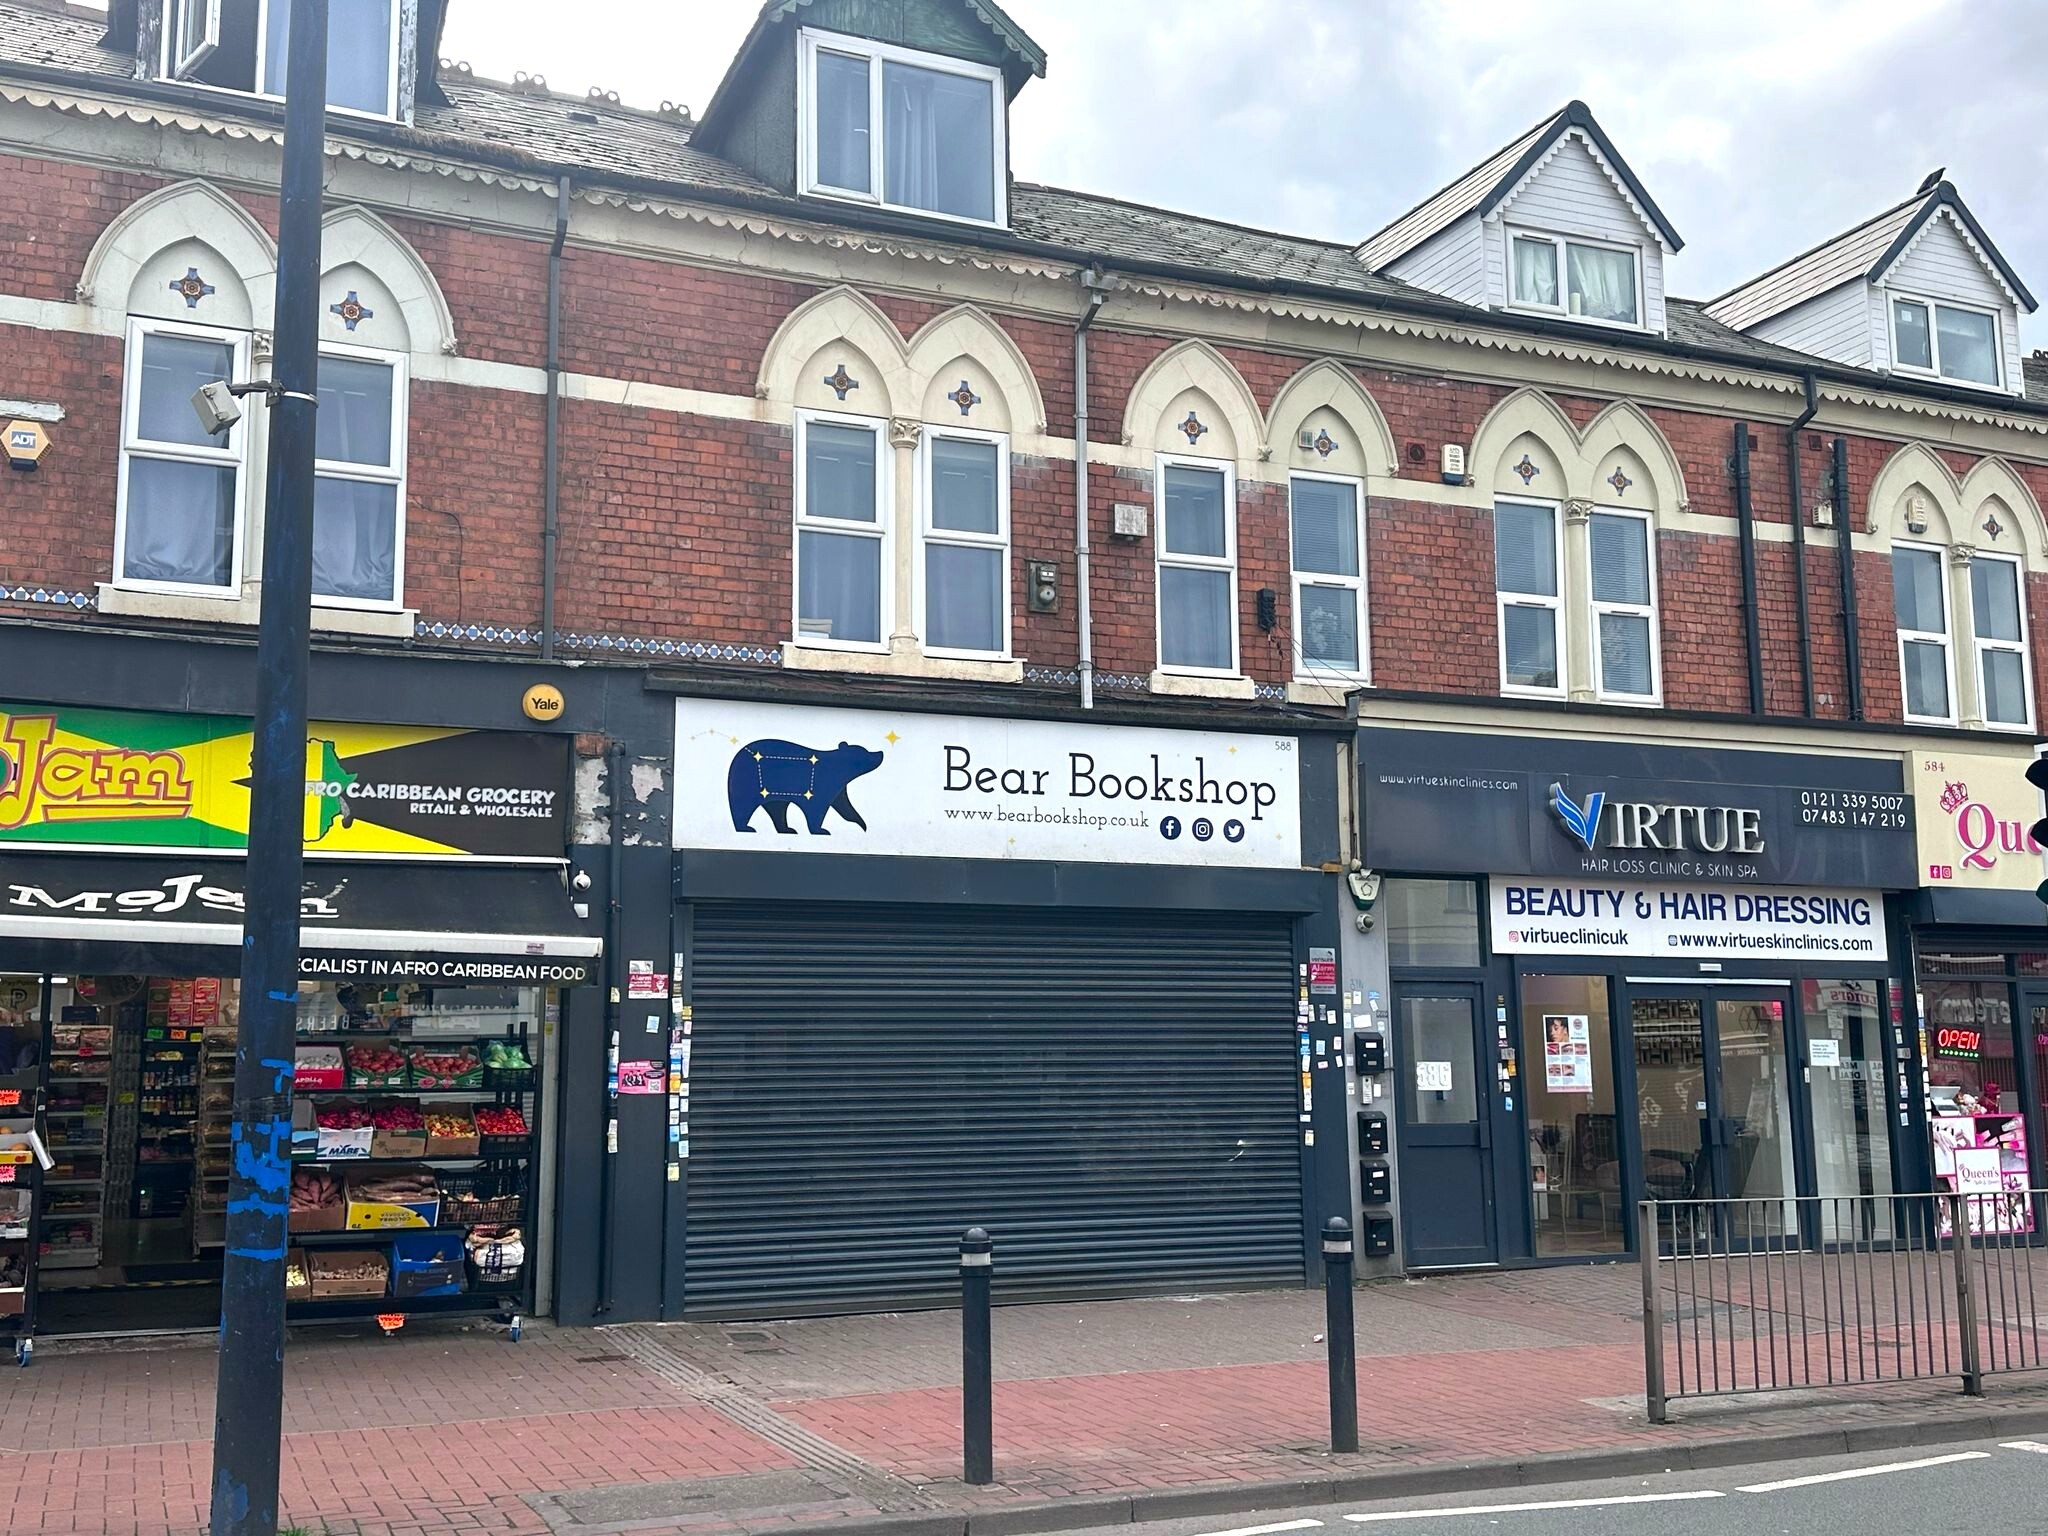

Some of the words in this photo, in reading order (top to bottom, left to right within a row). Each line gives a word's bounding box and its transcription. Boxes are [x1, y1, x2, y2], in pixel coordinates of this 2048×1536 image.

[11, 434, 36, 446] ADT
[532, 697, 559, 710] Yale
[1275, 740, 1292, 751] 588
[1924, 761, 1945, 772] 584
[943, 745, 1050, 797] Bear
[1068, 752, 1277, 820] Bookshop
[1379, 774, 1518, 790] www.virtueskinclinics.com
[305, 781, 341, 797] FRO
[346, 782, 462, 802] CARIBBEAN
[466, 787, 556, 805] GROCERY
[1801, 791, 1836, 807] 0121
[1842, 794, 1867, 809] 339
[1871, 796, 1903, 810] 5007
[410, 803, 456, 815] RETAIL
[459, 804, 471, 815] &
[474, 804, 553, 818] WHOLESALE
[944, 805, 1150, 831] www.bearbookshop.co.uk
[1550, 782, 1765, 853] VIRTUE
[1802, 809, 1846, 825] 07483
[1852, 812, 1875, 826] 147
[1881, 813, 1906, 828] 219
[1581, 858, 1609, 872] HAIR
[1613, 859, 1645, 873] LOSS
[1649, 861, 1691, 876] CLINIC
[1695, 863, 1704, 875] &
[1707, 863, 1734, 877] SKIN
[1737, 864, 1758, 878] SPA
[1505, 887, 1626, 918] BEAUTY
[1634, 891, 1651, 919] &
[1660, 893, 1727, 921] HAIR
[1735, 894, 1871, 925] DRESSING
[1520, 927, 1629, 946] virtueclinicuk
[1680, 933, 1873, 951] www.virtueskinclinics.com
[372, 959, 388, 975] IN
[391, 961, 440, 977] AFRO
[442, 962, 538, 979] CARIBBEAN
[540, 965, 587, 981] FOOD
[1312, 964, 1335, 972] Alarm
[1938, 1028, 1980, 1050] OPEN
[1961, 1166, 2000, 1182] Queen's
